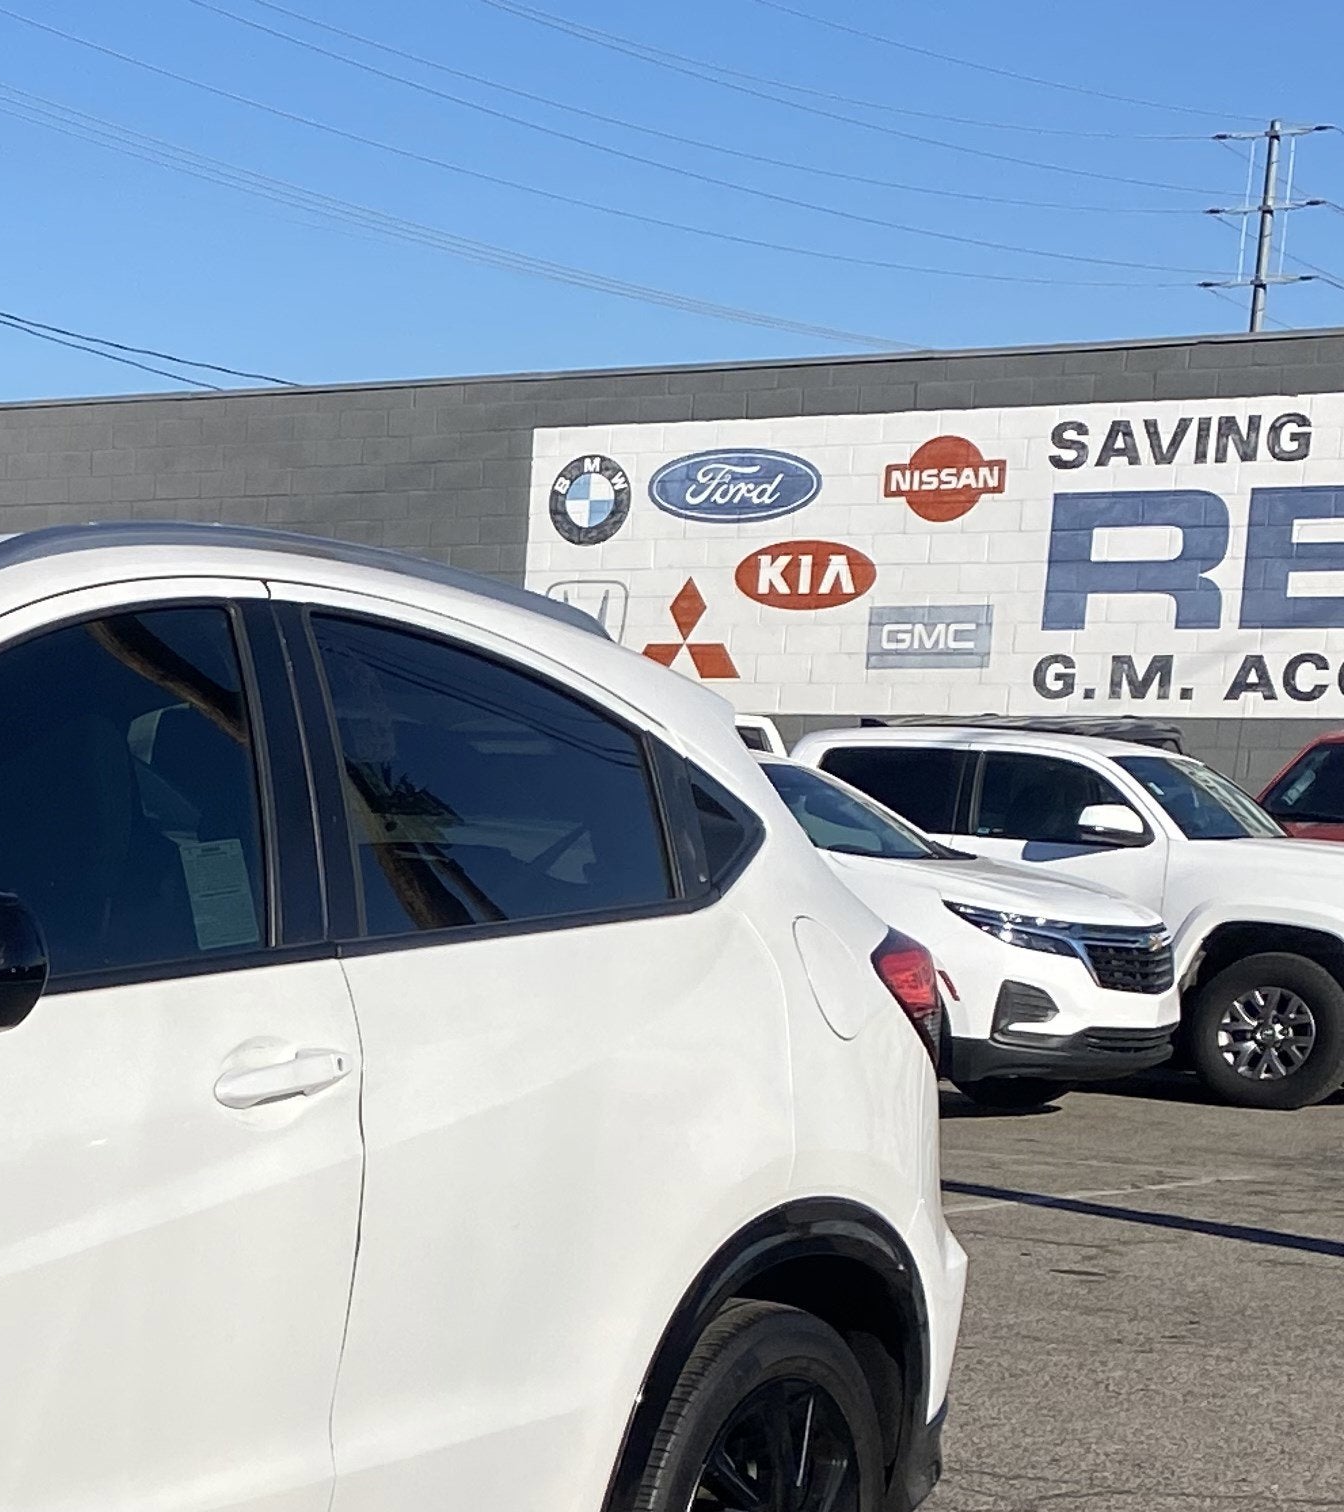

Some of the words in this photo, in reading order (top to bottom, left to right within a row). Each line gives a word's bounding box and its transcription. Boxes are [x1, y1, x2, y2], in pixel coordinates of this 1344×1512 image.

[1048, 412, 1313, 471] SAVING
[556, 457, 629, 495] BMW
[685, 463, 785, 507] Ford
[890, 465, 1000, 492] NISSAN
[756, 553, 856, 597] KIA
[879, 622, 977, 650] GMC
[1032, 653, 1194, 701] G.M.
[1223, 652, 1344, 701] AC
